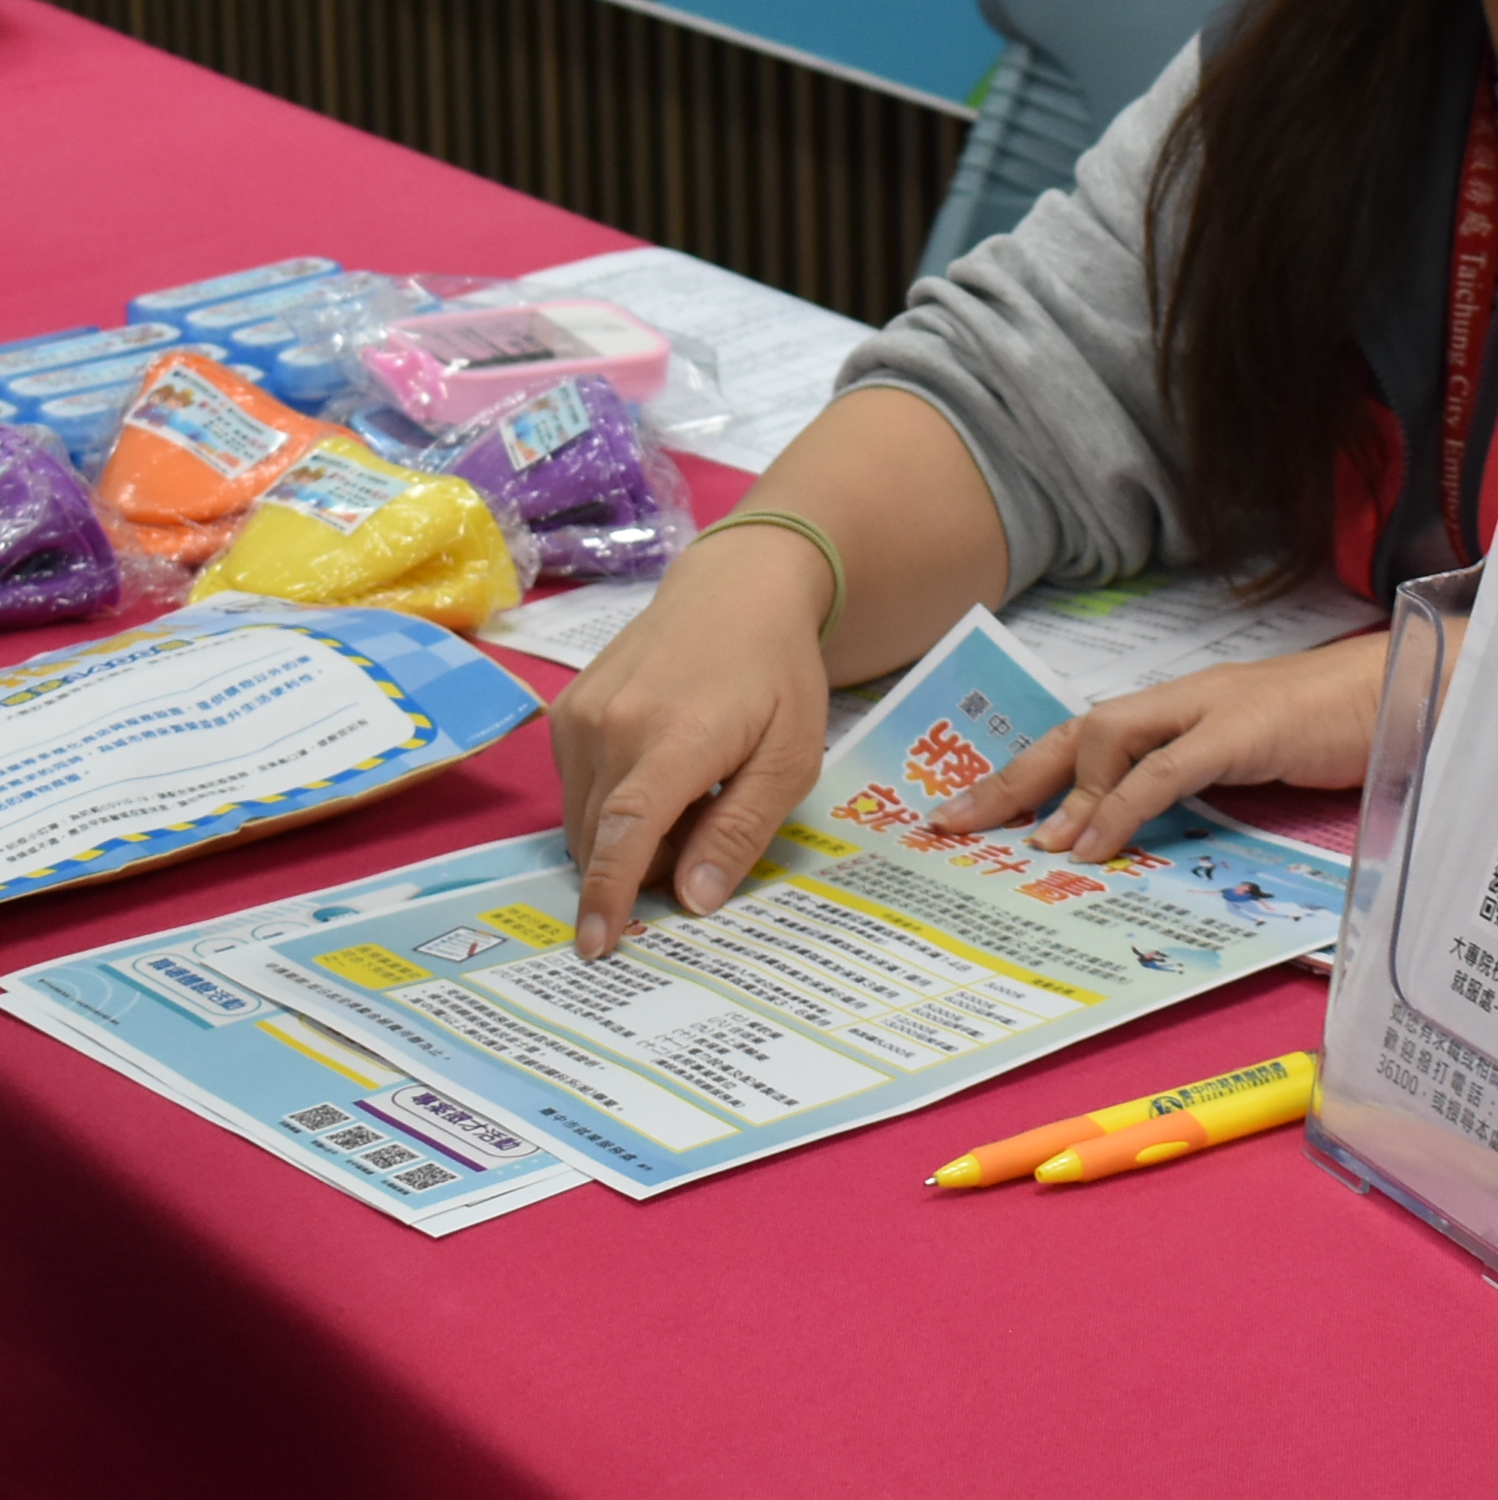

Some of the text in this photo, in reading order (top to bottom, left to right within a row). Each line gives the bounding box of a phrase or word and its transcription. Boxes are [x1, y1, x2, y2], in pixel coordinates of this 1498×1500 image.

[410, 1089, 523, 1154] 專案徵才活動
